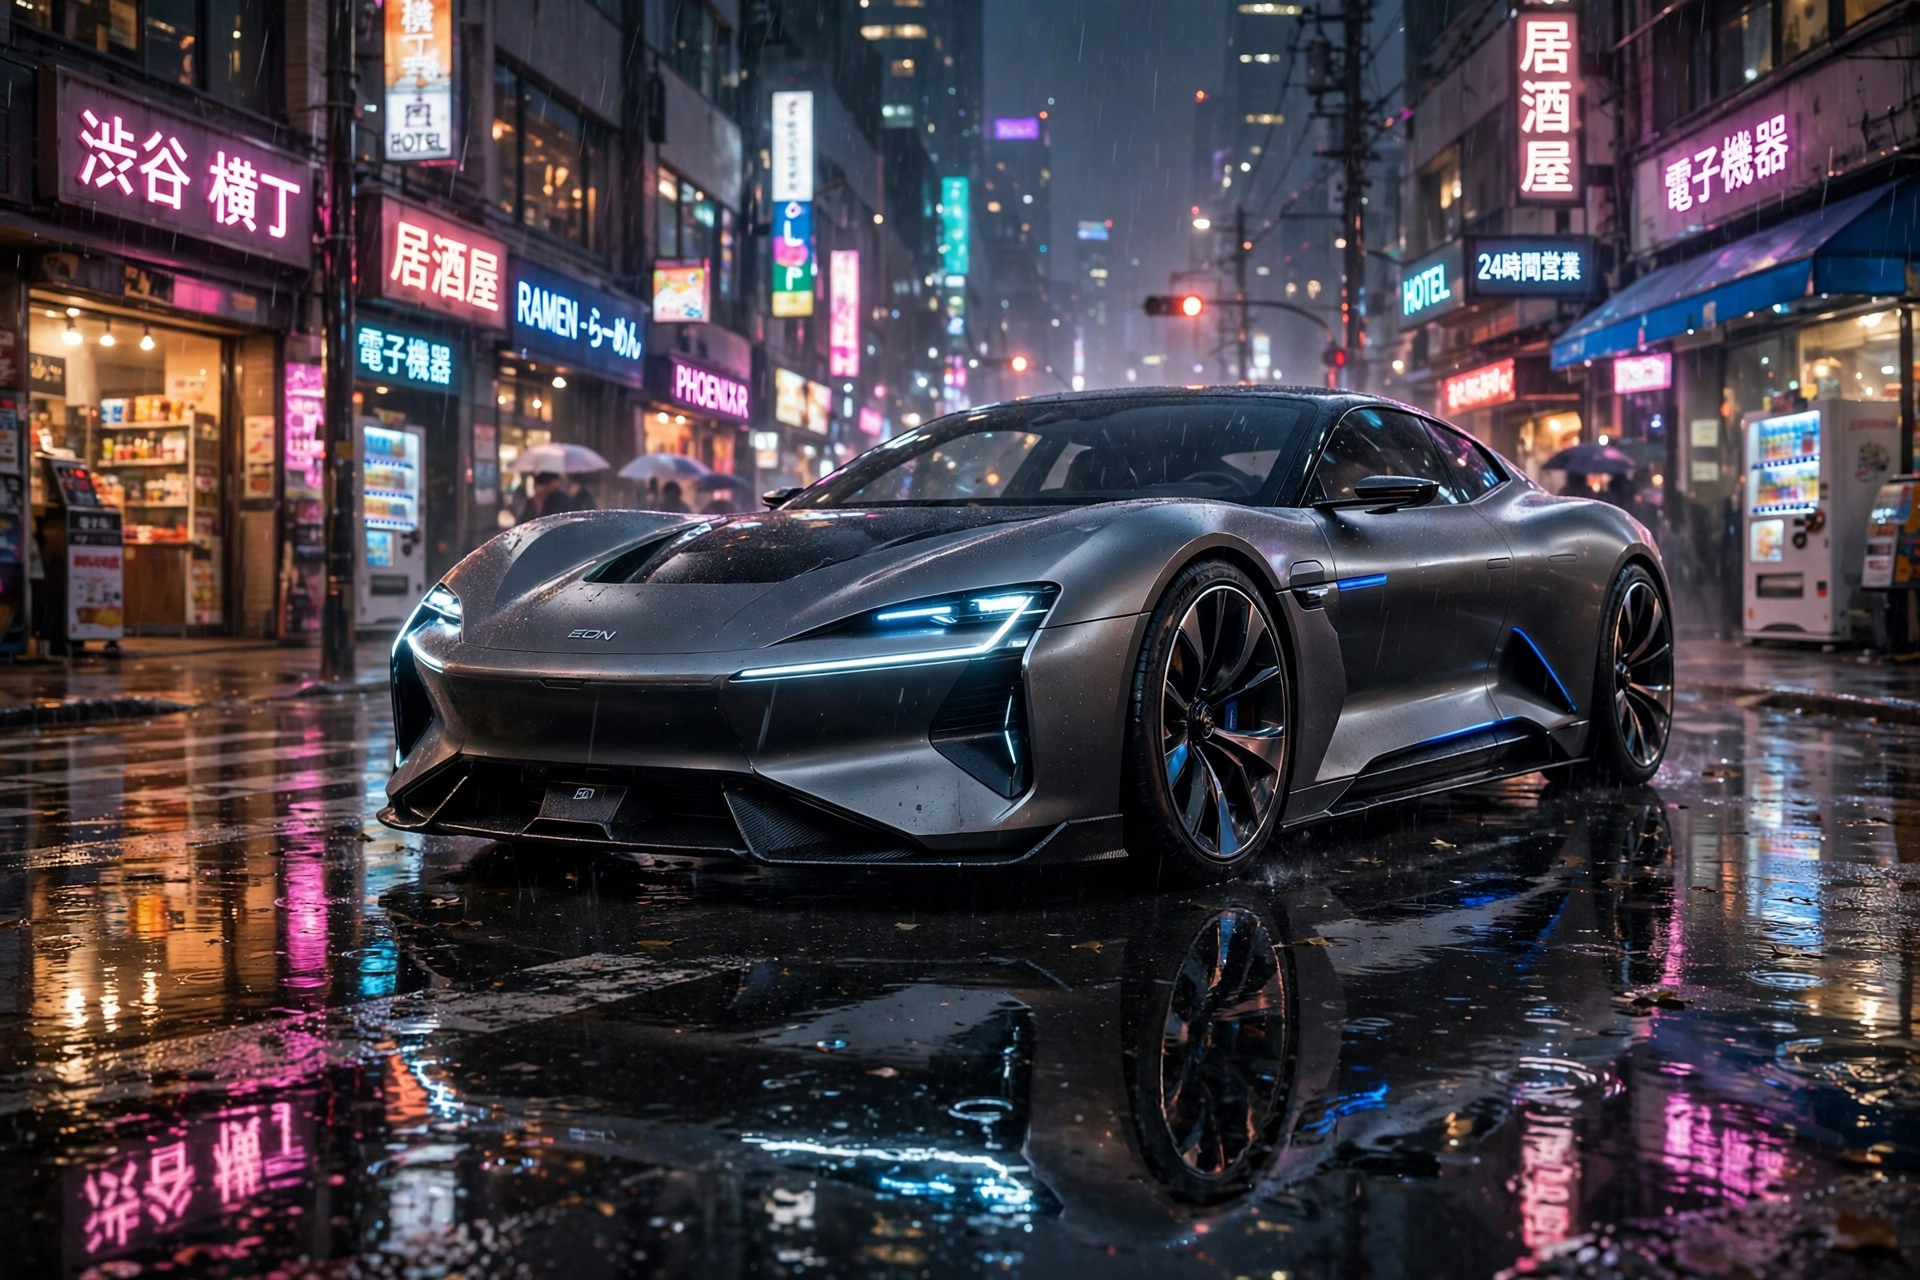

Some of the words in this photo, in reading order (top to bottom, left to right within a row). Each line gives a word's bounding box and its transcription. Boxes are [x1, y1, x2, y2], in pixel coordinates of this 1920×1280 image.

[1520, 21, 1573, 192] 居酒屋
[79, 109, 191, 210] 渋谷
[208, 150, 301, 239] 横丁
[1665, 114, 1789, 212] 電子機器
[390, 221, 499, 312] 居酒屋
[1403, 263, 1450, 316] HOTEL
[1477, 250, 1581, 282] 24時間営業
[358, 327, 451, 385] 電子機器
[567, 628, 617, 641] EON
